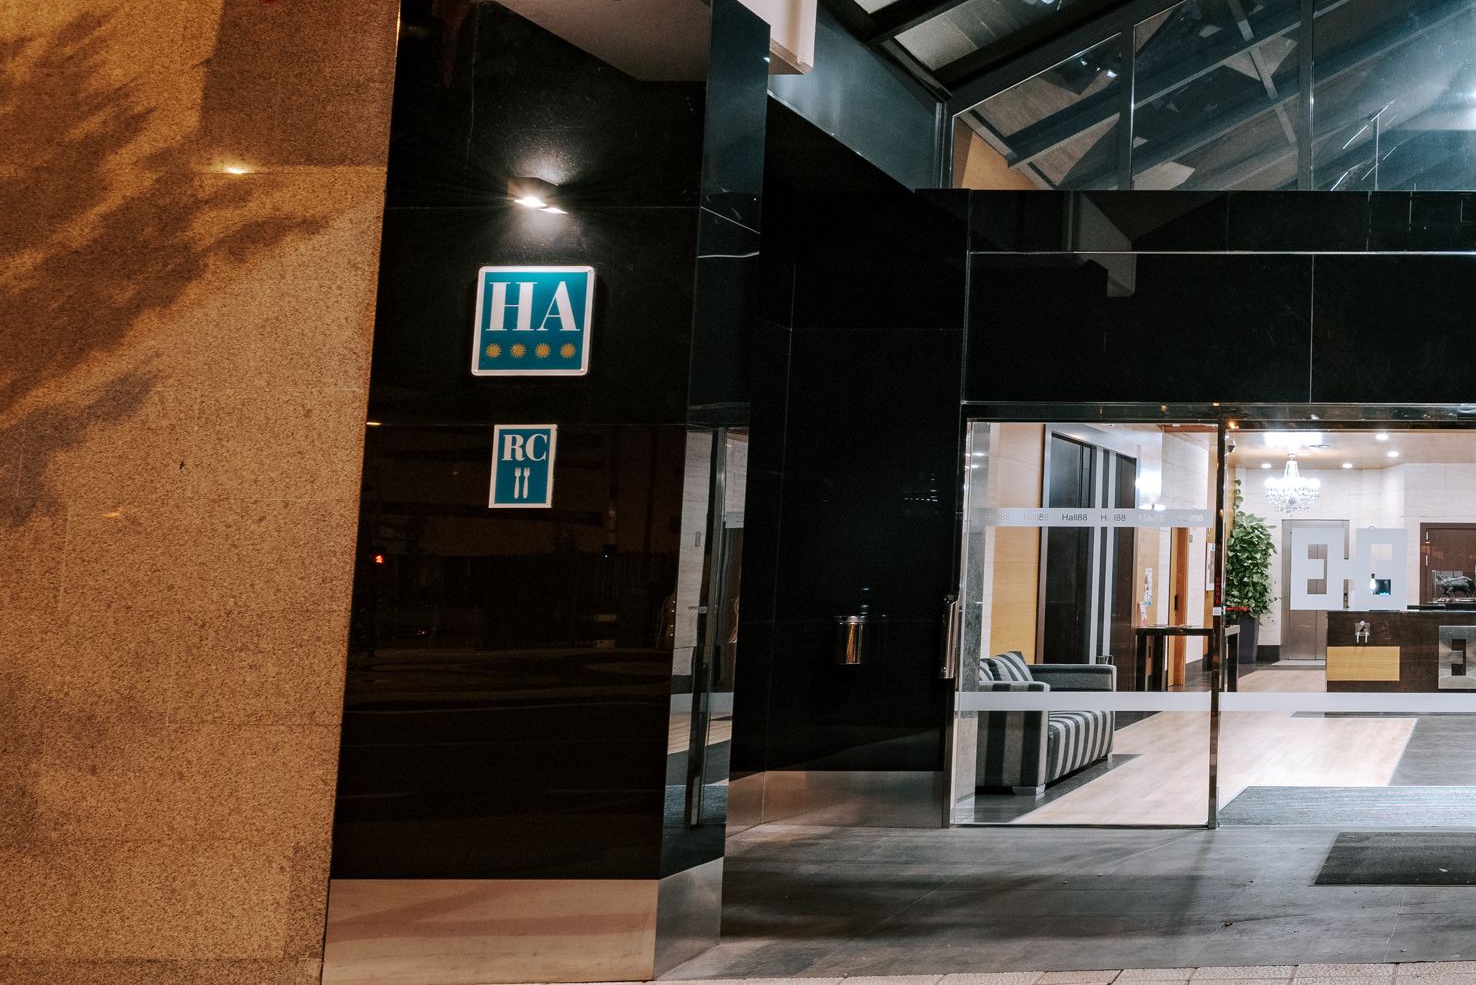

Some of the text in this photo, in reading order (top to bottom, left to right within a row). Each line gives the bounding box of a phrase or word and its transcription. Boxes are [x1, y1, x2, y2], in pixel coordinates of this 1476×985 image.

[485, 280, 581, 332] HA
[501, 433, 548, 462] RC
[1061, 513, 1088, 522] Hall88
